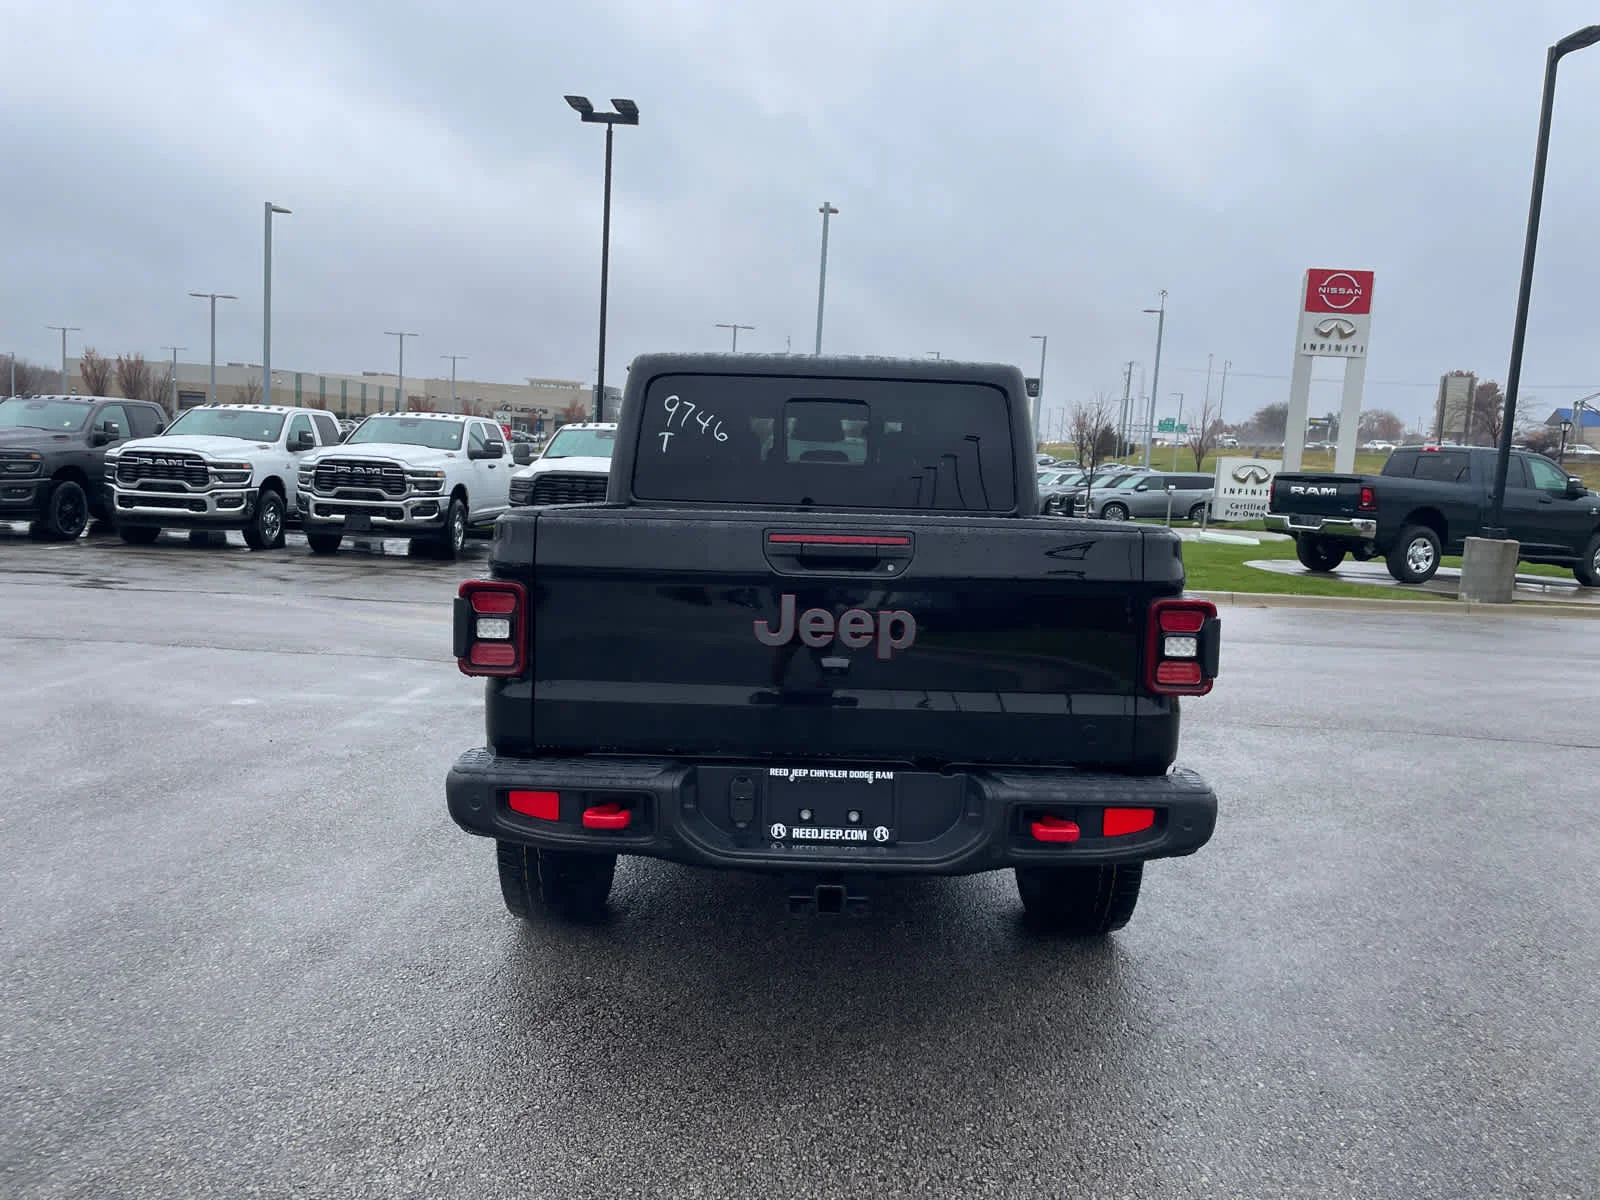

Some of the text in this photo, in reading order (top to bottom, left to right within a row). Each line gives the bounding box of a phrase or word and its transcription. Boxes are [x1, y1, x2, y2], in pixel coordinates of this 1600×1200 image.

[1318, 287, 1362, 295] NISSAN
[1303, 343, 1364, 353] INFINITI
[664, 394, 728, 442] 9746
[658, 431, 675, 453] T
[138, 457, 183, 466] RAM
[336, 466, 380, 475] RAM
[1223, 487, 1270, 497] INFINIT
[1290, 486, 1337, 496] RAM
[1225, 510, 1266, 518] Pre-Owne
[753, 594, 917, 659] Jeep
[769, 768, 894, 780] REED JEEP CHRYSLER DODGE RAM
[792, 828, 867, 841] REEDJEEP.COM
